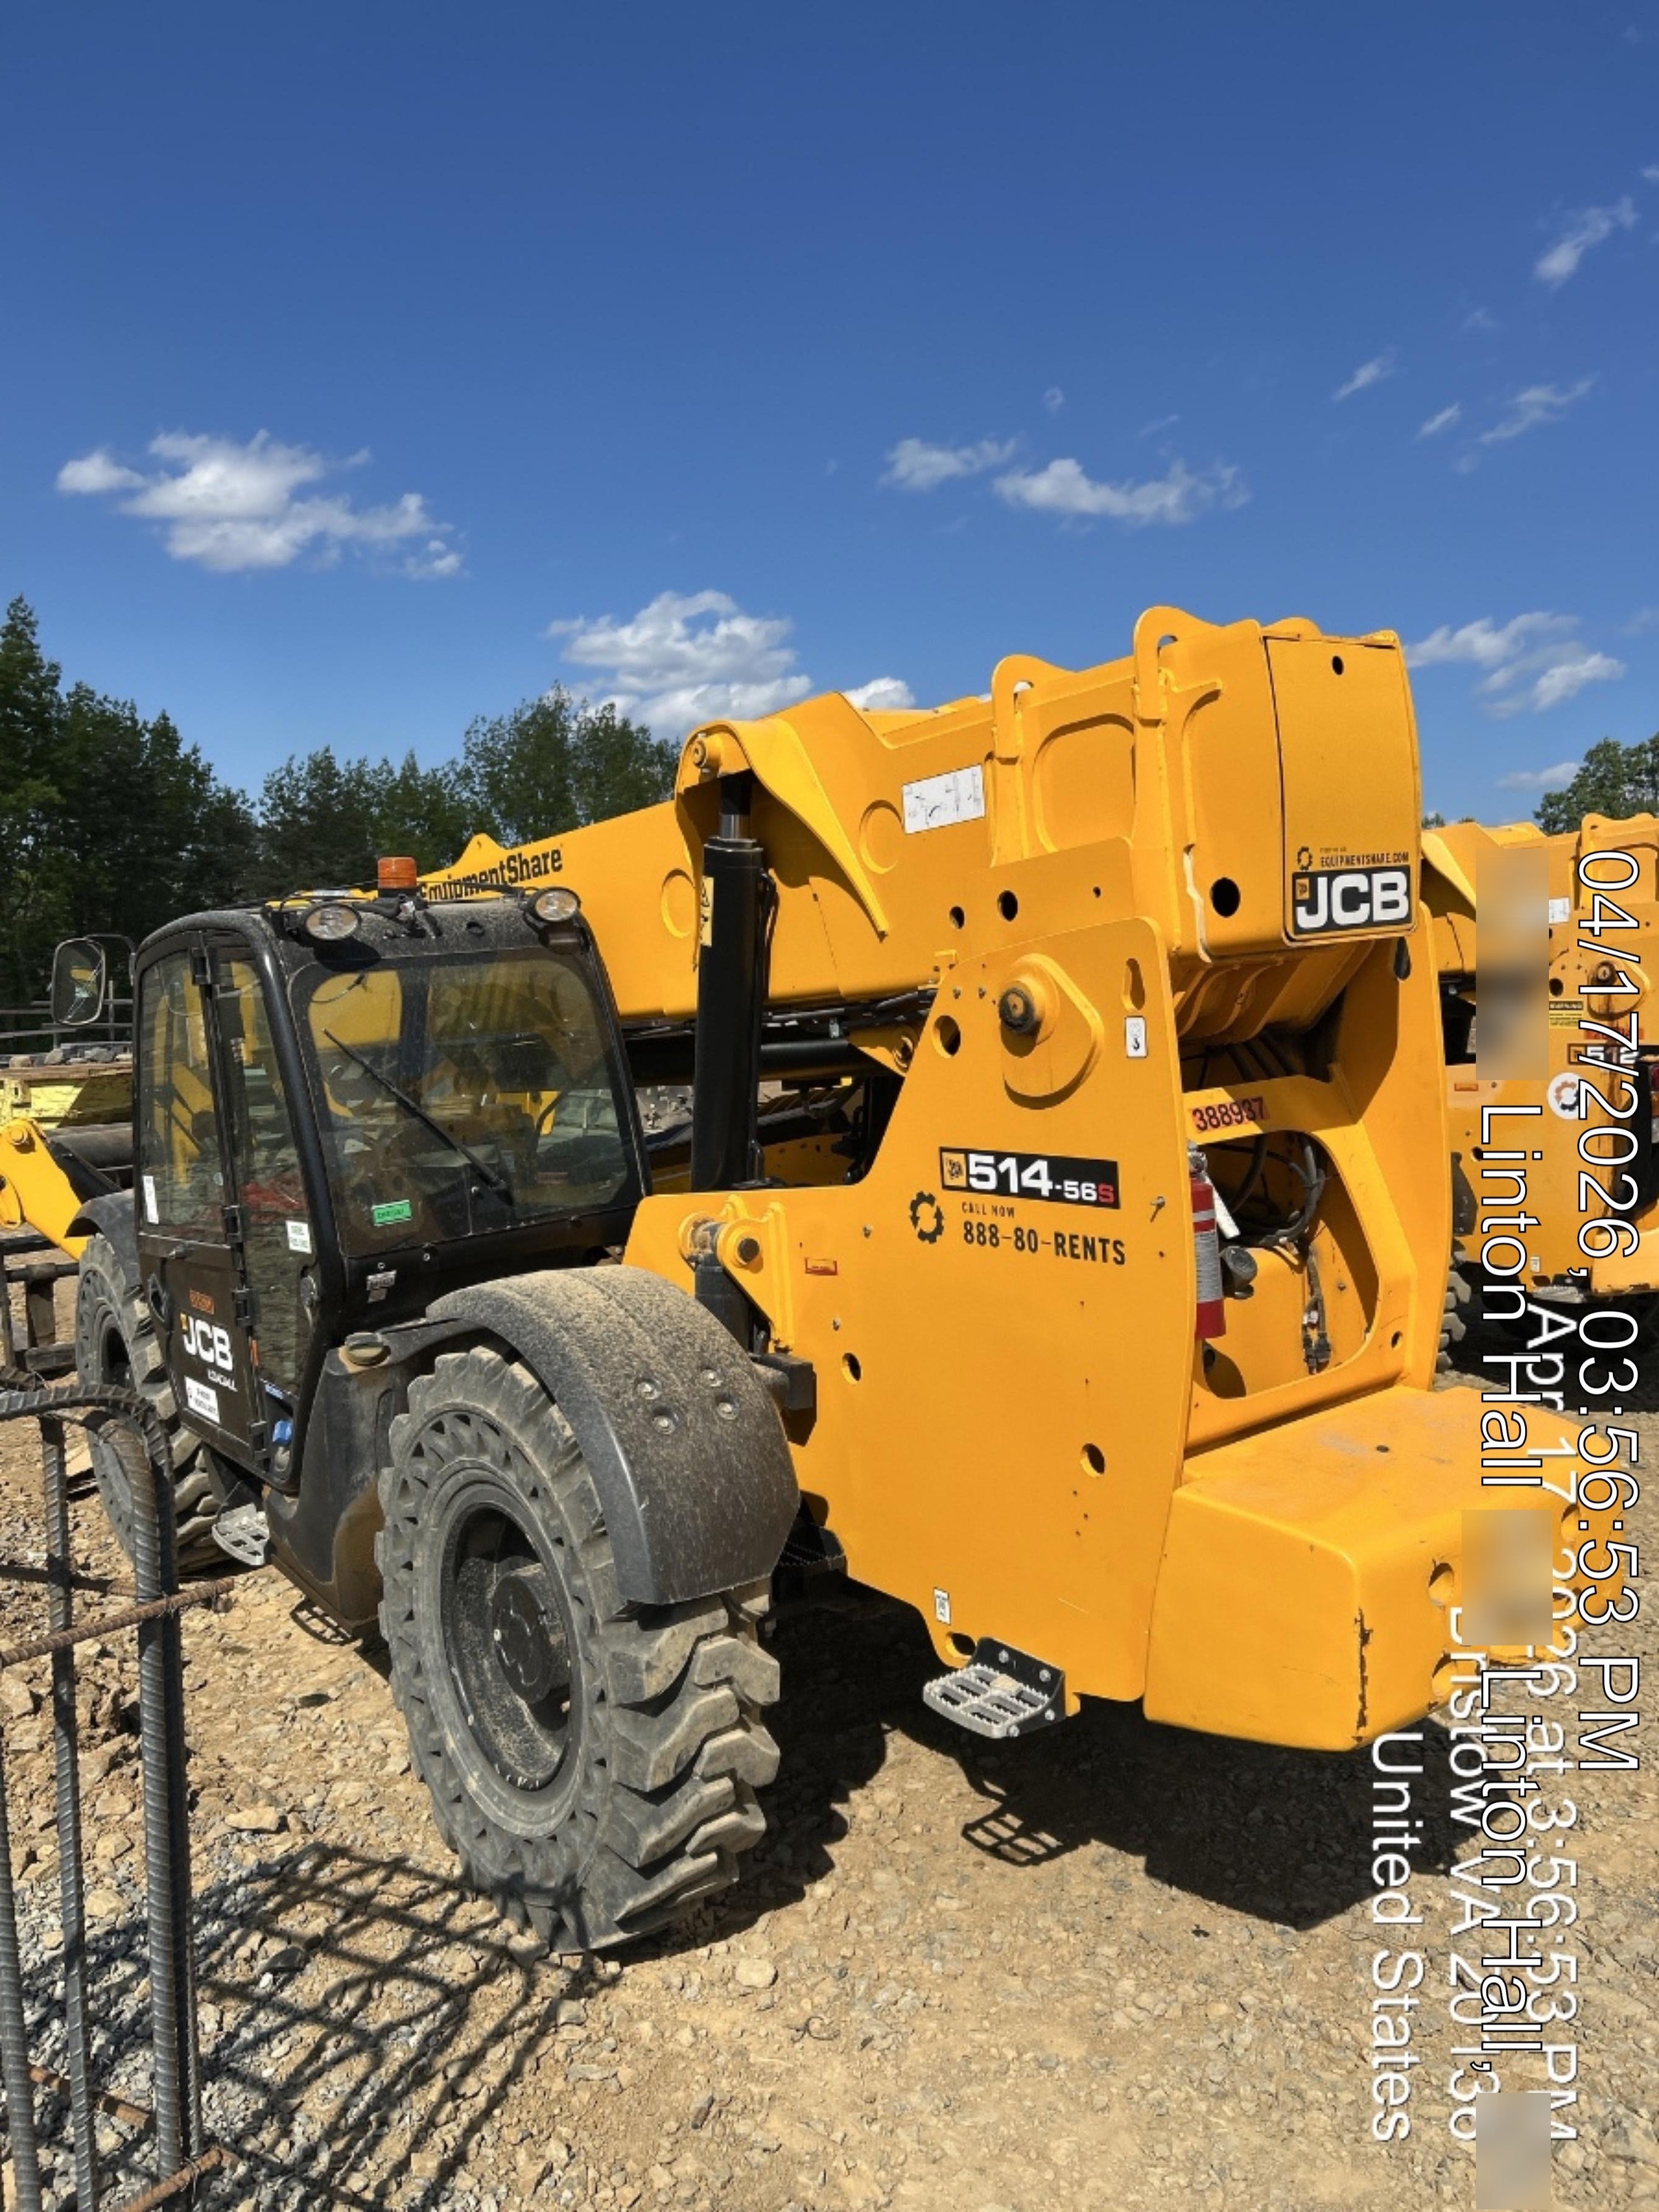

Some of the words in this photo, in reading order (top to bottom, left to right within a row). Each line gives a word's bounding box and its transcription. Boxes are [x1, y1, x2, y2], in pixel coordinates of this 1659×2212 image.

[1296, 871, 1409, 928] JCB
[1192, 1096, 1263, 1131] 388937
[962, 1201, 987, 1216] CALL
[991, 1206, 1014, 1218] NOW
[963, 1221, 1125, 1265] 888-80-RENTS
[183, 1315, 233, 1371] JCB
